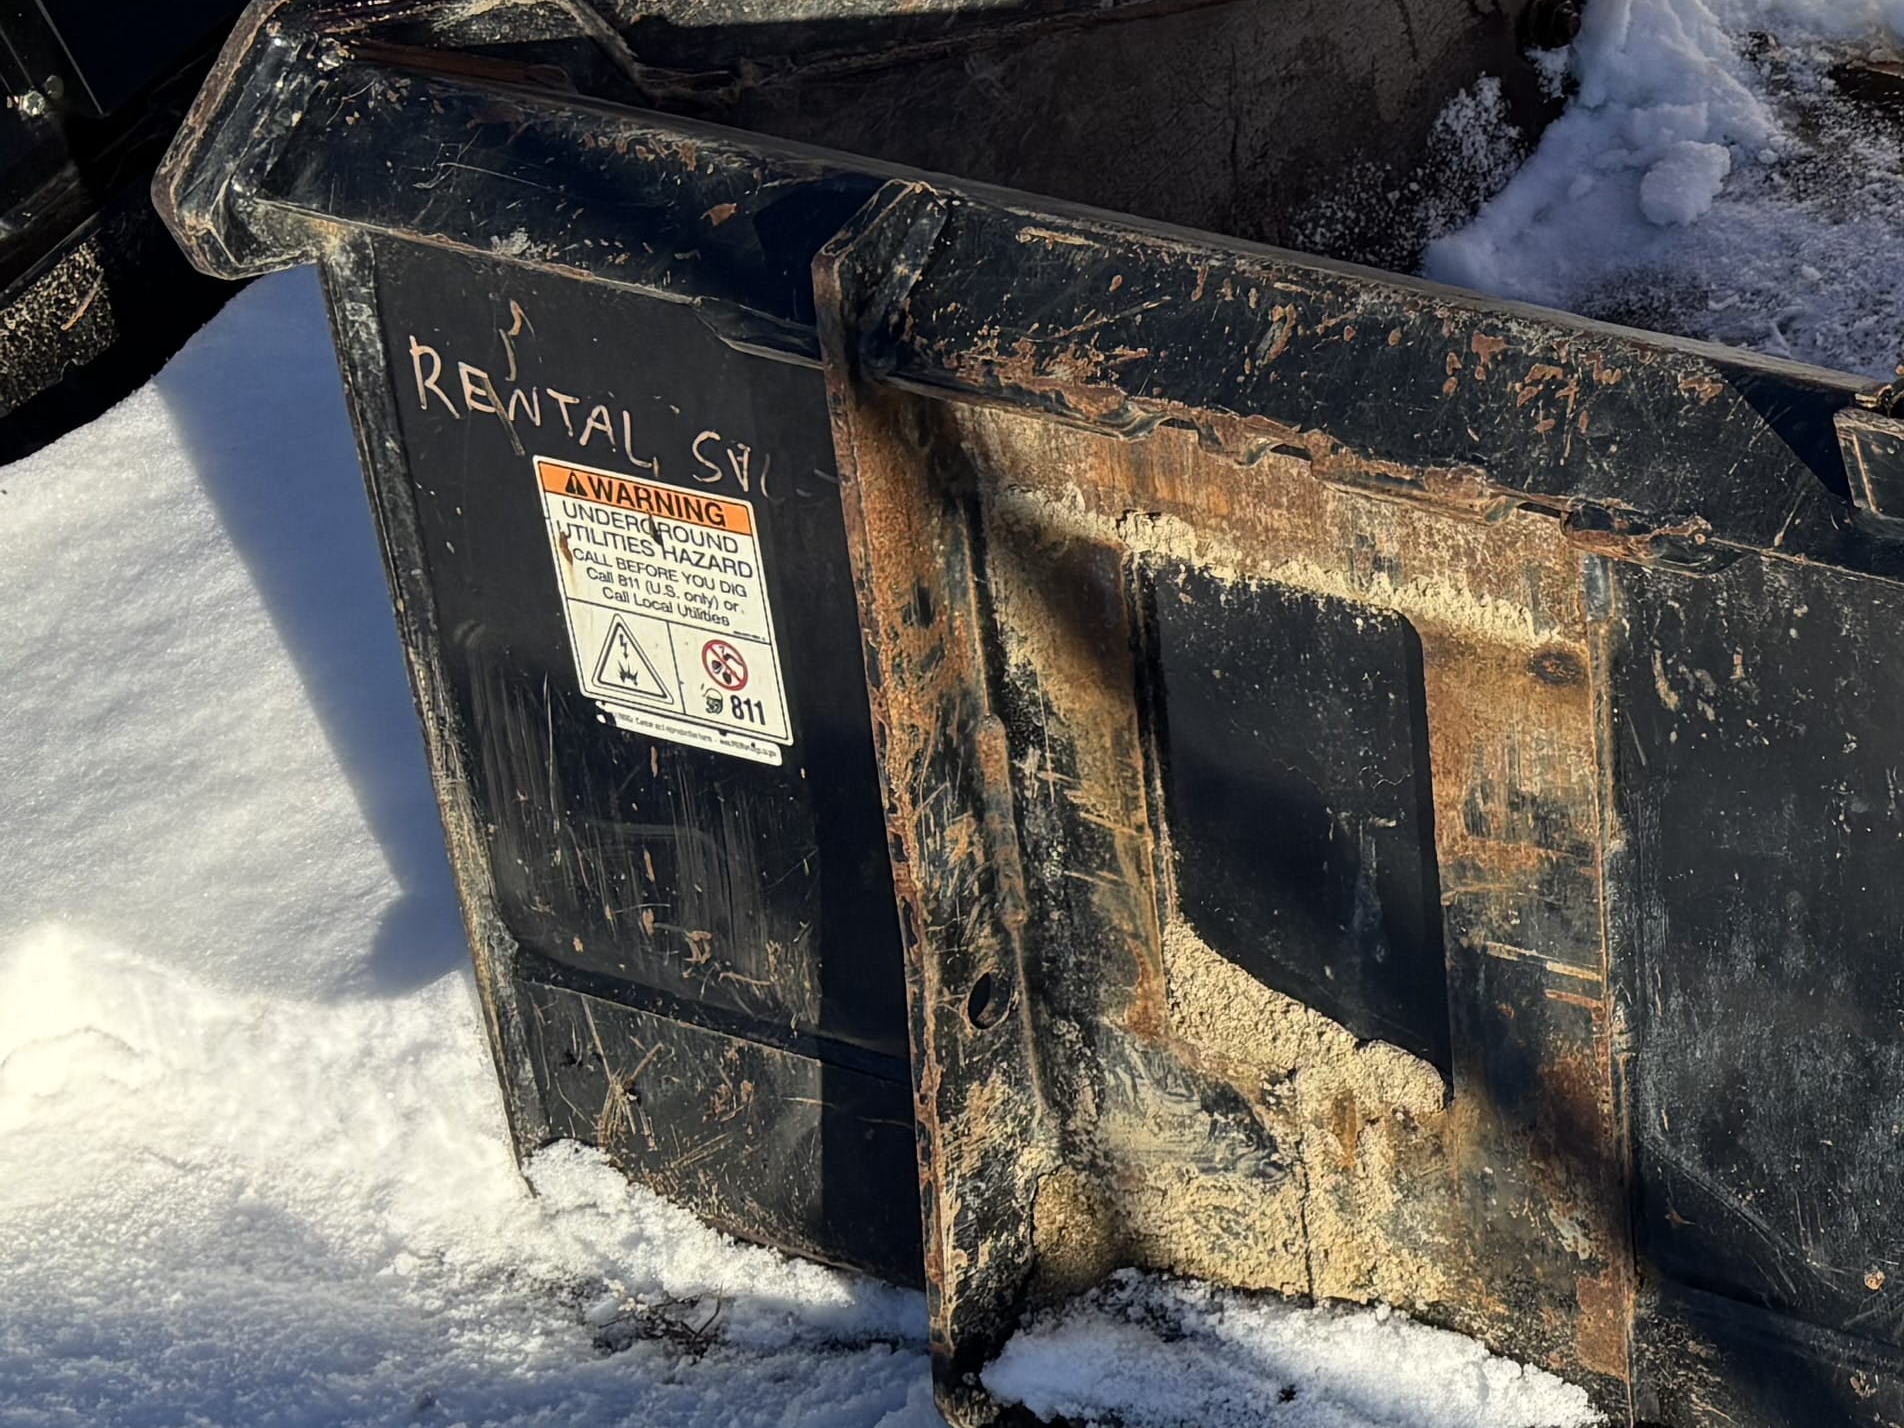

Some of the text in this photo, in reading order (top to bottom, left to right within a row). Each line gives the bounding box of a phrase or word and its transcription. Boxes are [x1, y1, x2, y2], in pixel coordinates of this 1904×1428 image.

[410, 335, 652, 468] RENTAL
[587, 475, 727, 527] WARNING
[556, 520, 753, 578] UTILITIES HAZARD
[572, 548, 748, 598] CALL BEFORE YOU DIG
[586, 567, 614, 584] Call
[618, 574, 640, 590] 811
[645, 579, 680, 600] (U.S.
[684, 591, 719, 610] only)
[602, 587, 730, 627] Call Local Utilities
[730, 694, 766, 726] 811
